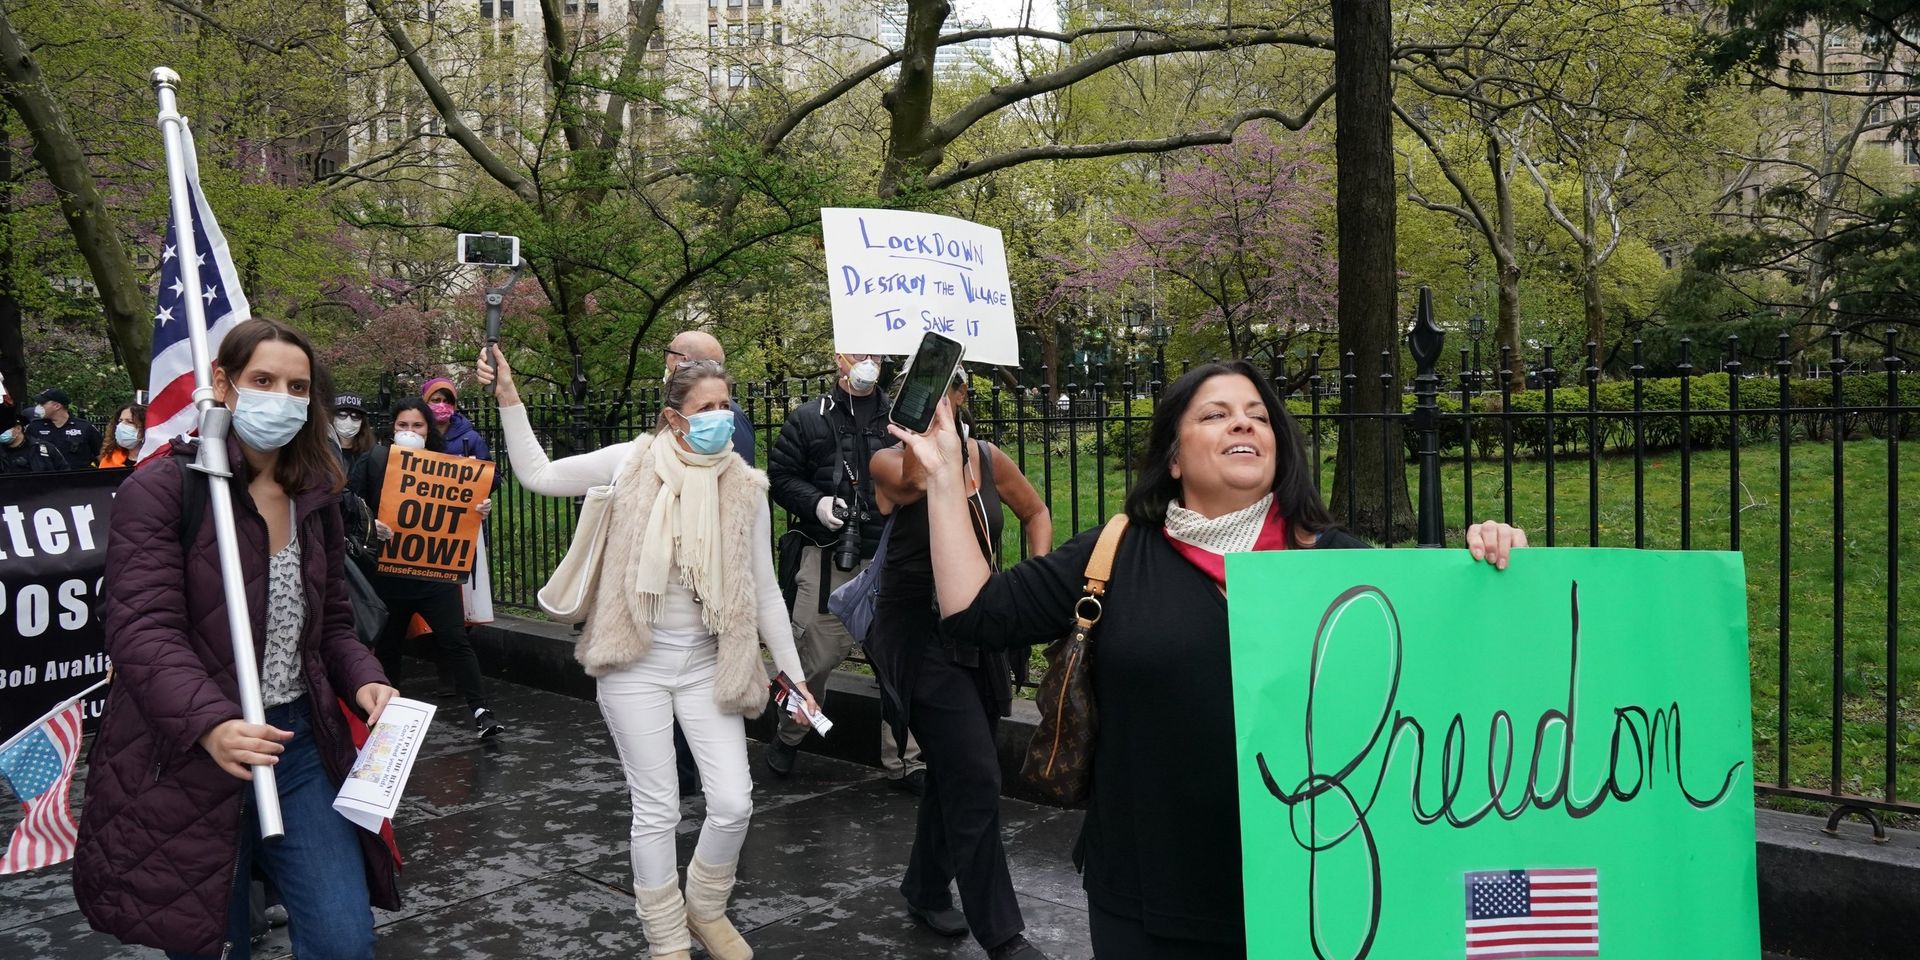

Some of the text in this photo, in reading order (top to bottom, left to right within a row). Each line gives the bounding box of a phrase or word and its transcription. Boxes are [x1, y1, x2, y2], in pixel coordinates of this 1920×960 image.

[841, 265, 1007, 306] DESTROY THE VILLAGE
[966, 319, 981, 337] IT
[399, 450, 486, 485] Trump/
[399, 474, 474, 503] Pence
[397, 499, 468, 534] OUT
[378, 532, 471, 568] NOW!
[377, 563, 459, 581] RefuseFascism.org
[400, 742, 410, 756] PAY
[393, 758, 403, 773] THE
